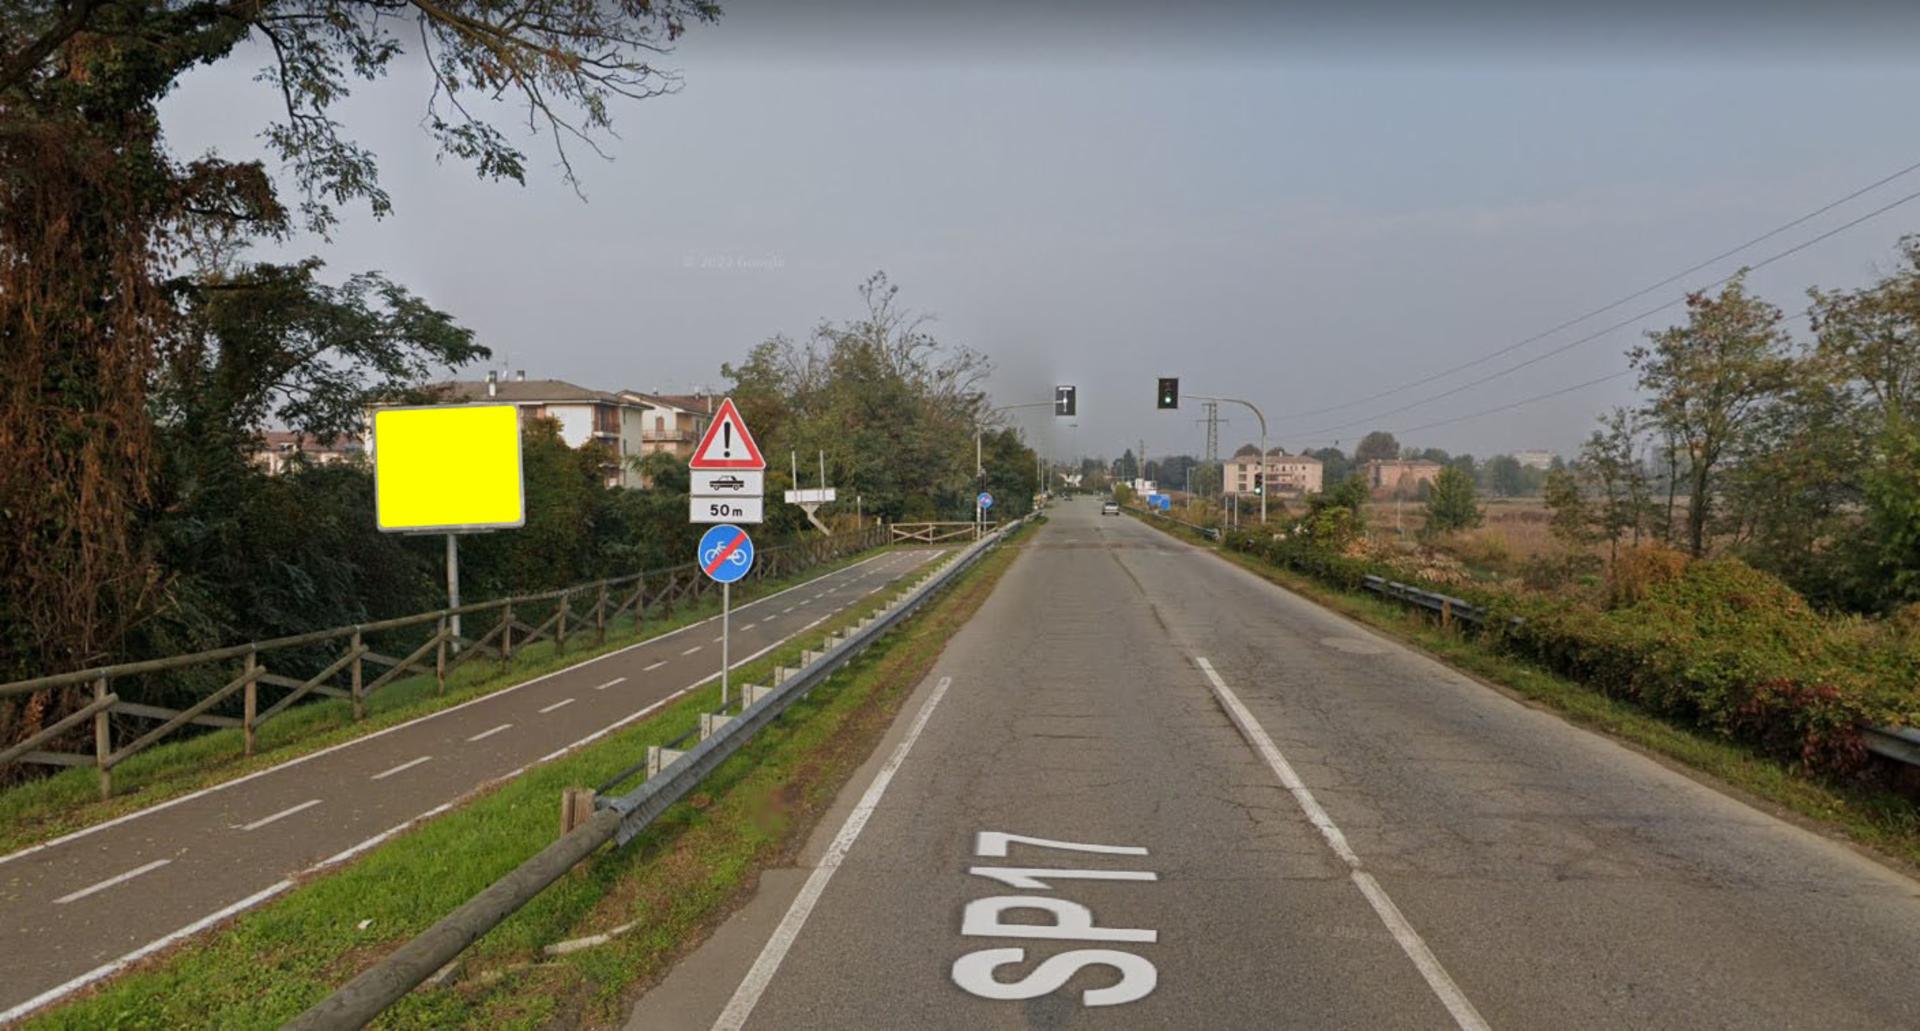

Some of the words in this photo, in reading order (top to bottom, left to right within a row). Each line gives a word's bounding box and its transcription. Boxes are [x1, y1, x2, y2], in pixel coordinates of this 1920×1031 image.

[710, 504, 730, 517] 50
[732, 509, 743, 517] m
[952, 831, 1158, 1007] SP17
